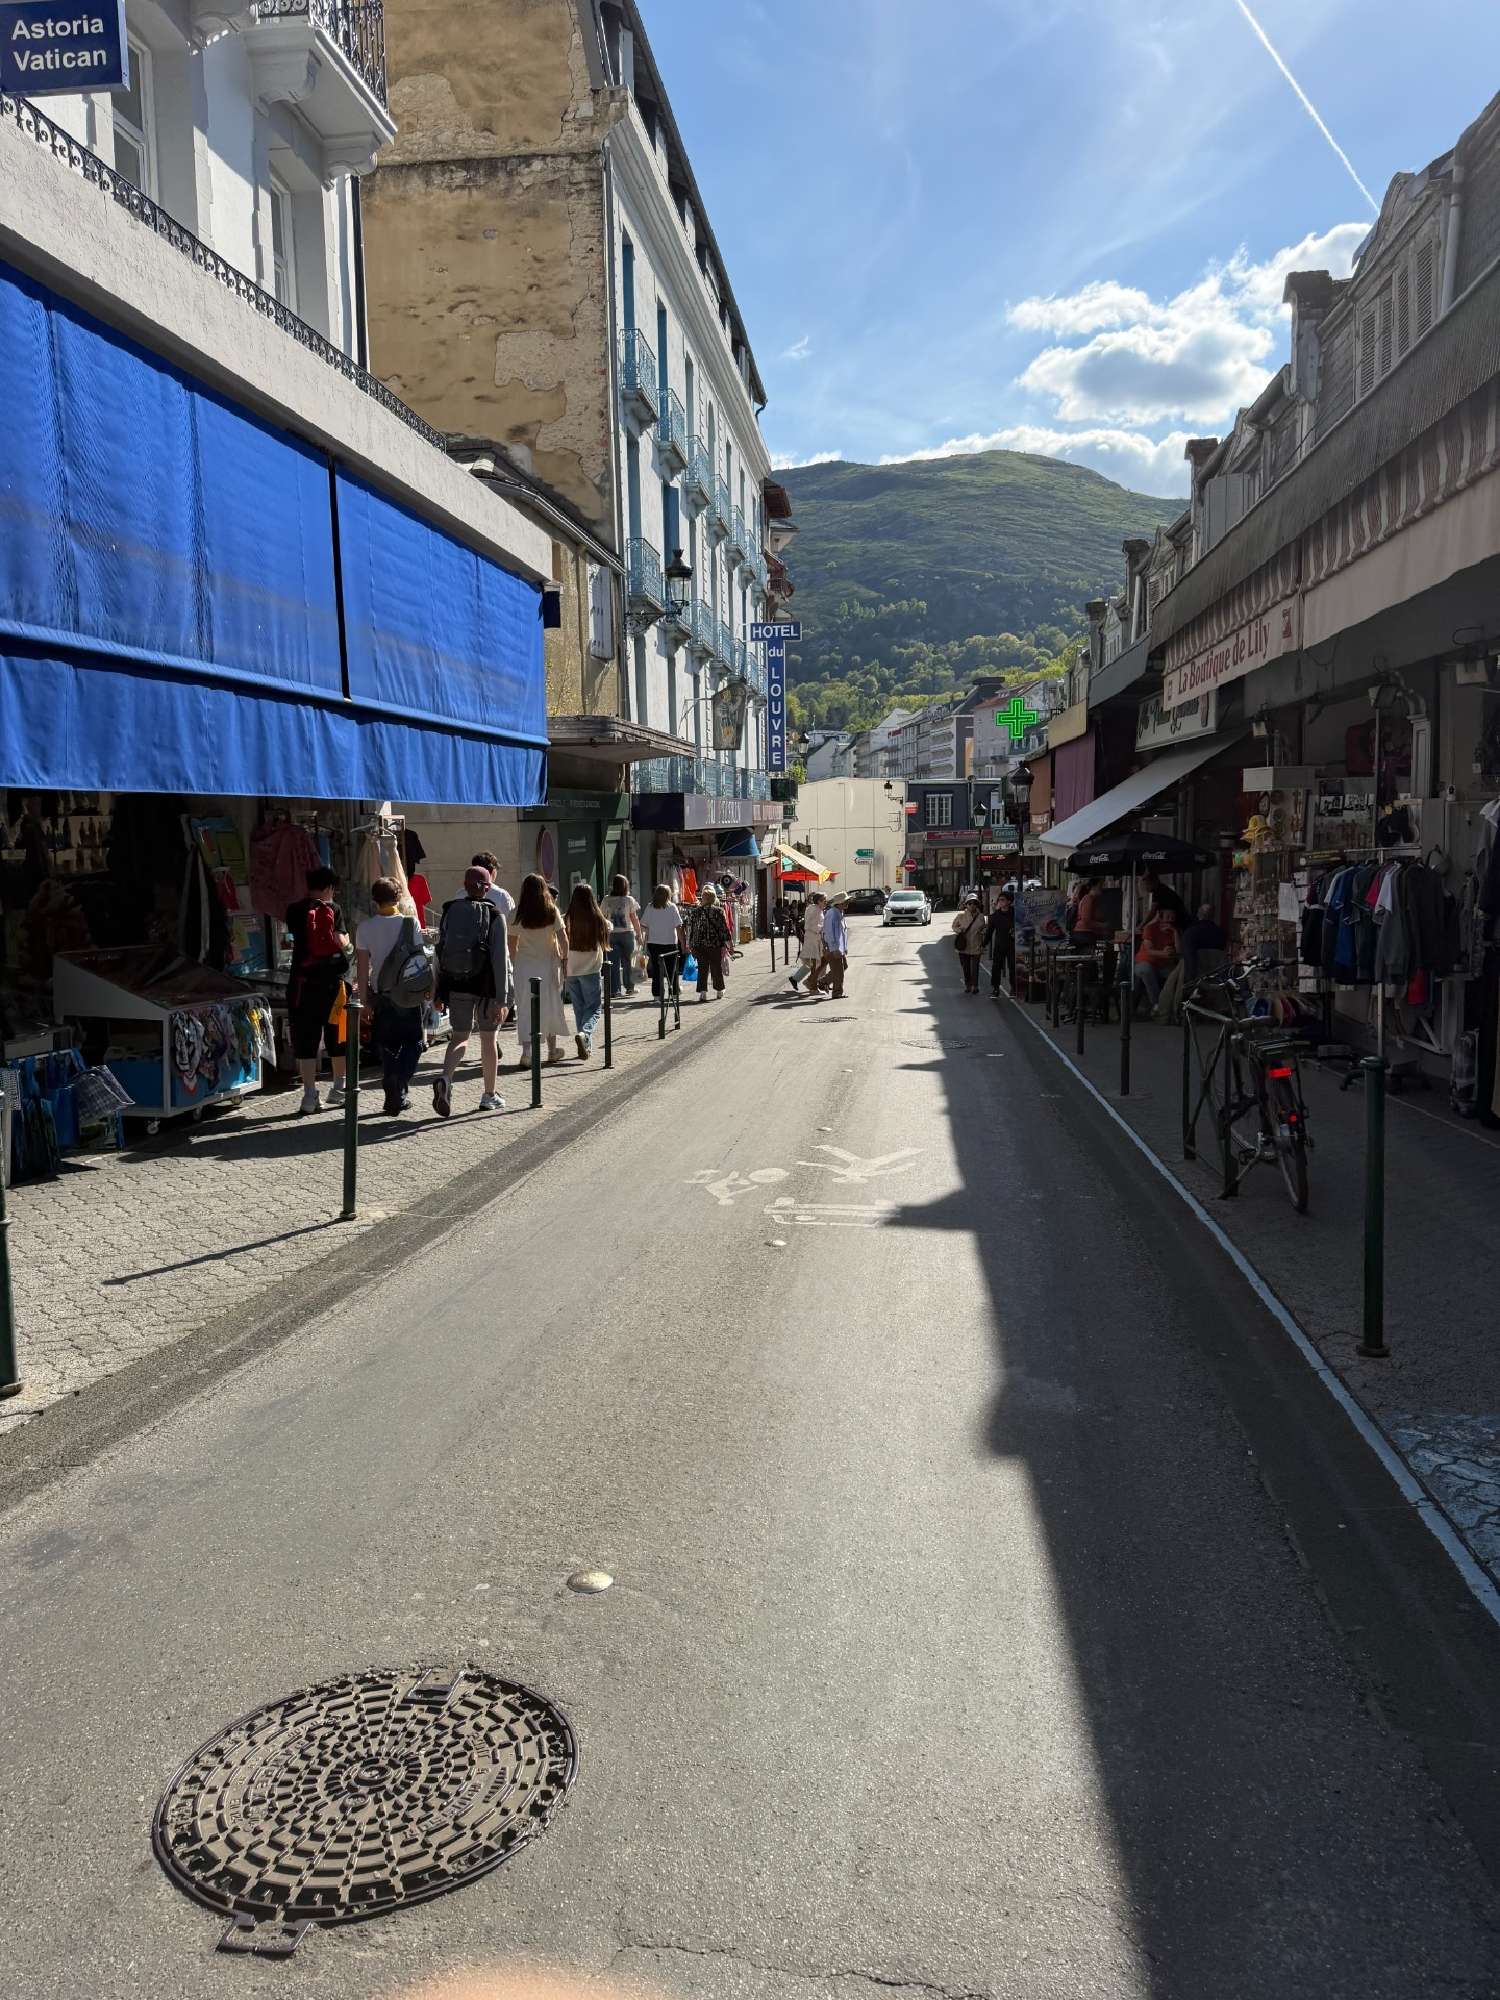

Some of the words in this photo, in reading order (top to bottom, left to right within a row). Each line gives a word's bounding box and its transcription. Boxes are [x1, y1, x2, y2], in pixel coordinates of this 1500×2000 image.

[12, 14, 104, 40] Astoria
[13, 48, 107, 71] Vatican
[752, 624, 799, 639] HOTEL
[768, 646, 783, 657] du
[1179, 668, 1187, 694] La
[1190, 648, 1231, 690] Boutique
[1233, 632, 1245, 666] de
[1248, 617, 1270, 659] Lily
[770, 667, 781, 765] LOUVRE
